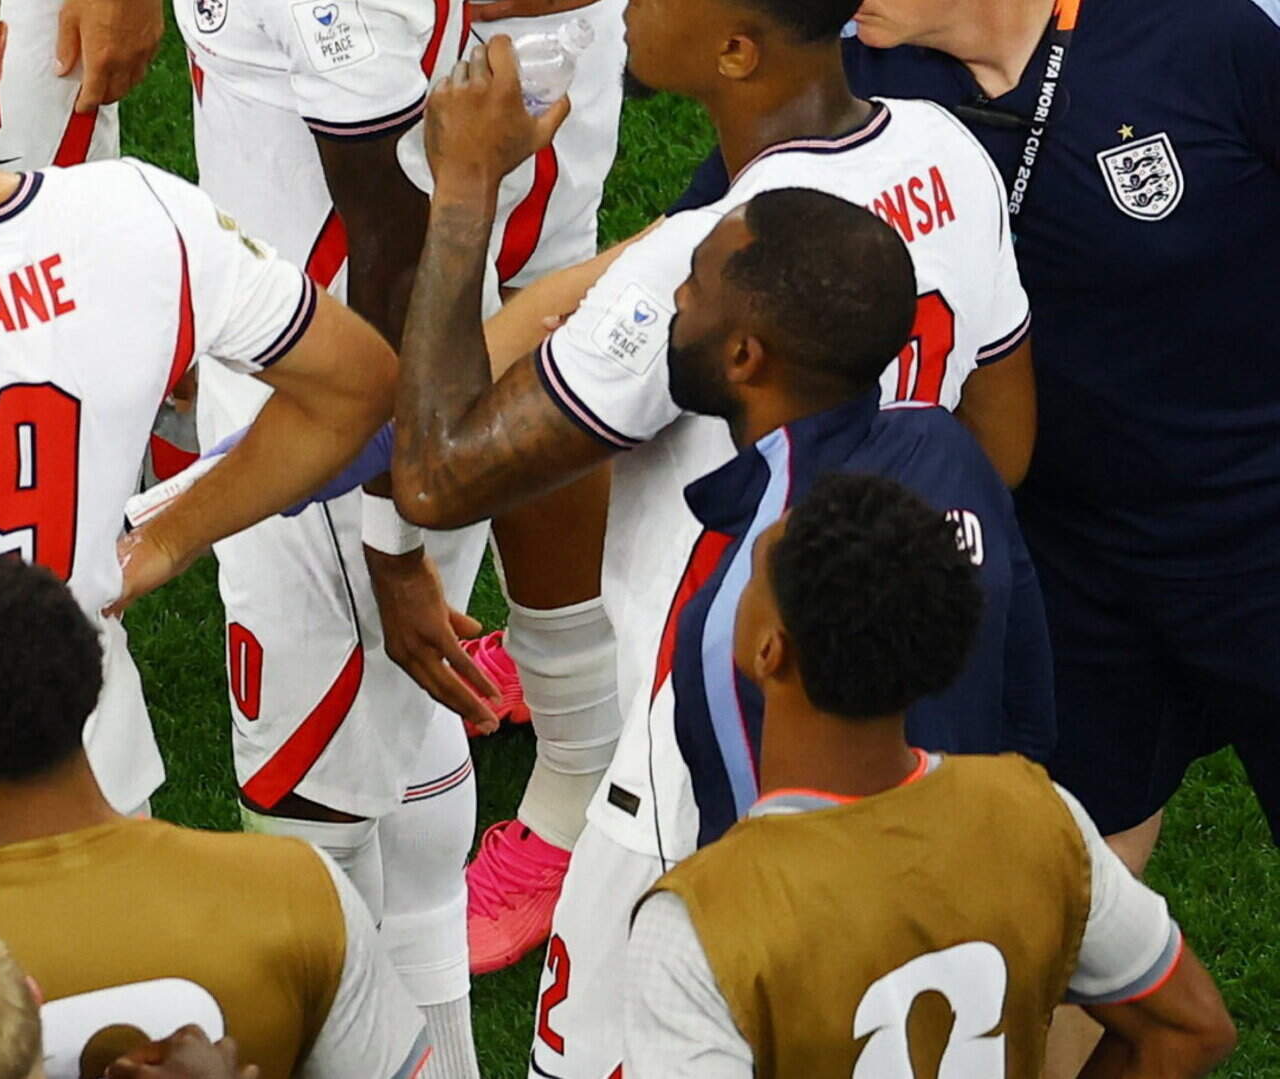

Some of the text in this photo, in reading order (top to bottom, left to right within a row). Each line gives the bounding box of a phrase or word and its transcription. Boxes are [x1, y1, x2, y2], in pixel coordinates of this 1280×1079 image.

[321, 35, 355, 57] PEACE
[1045, 45, 1065, 78] FIFA
[1022, 137, 1040, 166] CUP
[1008, 166, 1031, 215] 2026
[607, 328, 640, 358] PEACE
[537, 932, 571, 1056] 2
